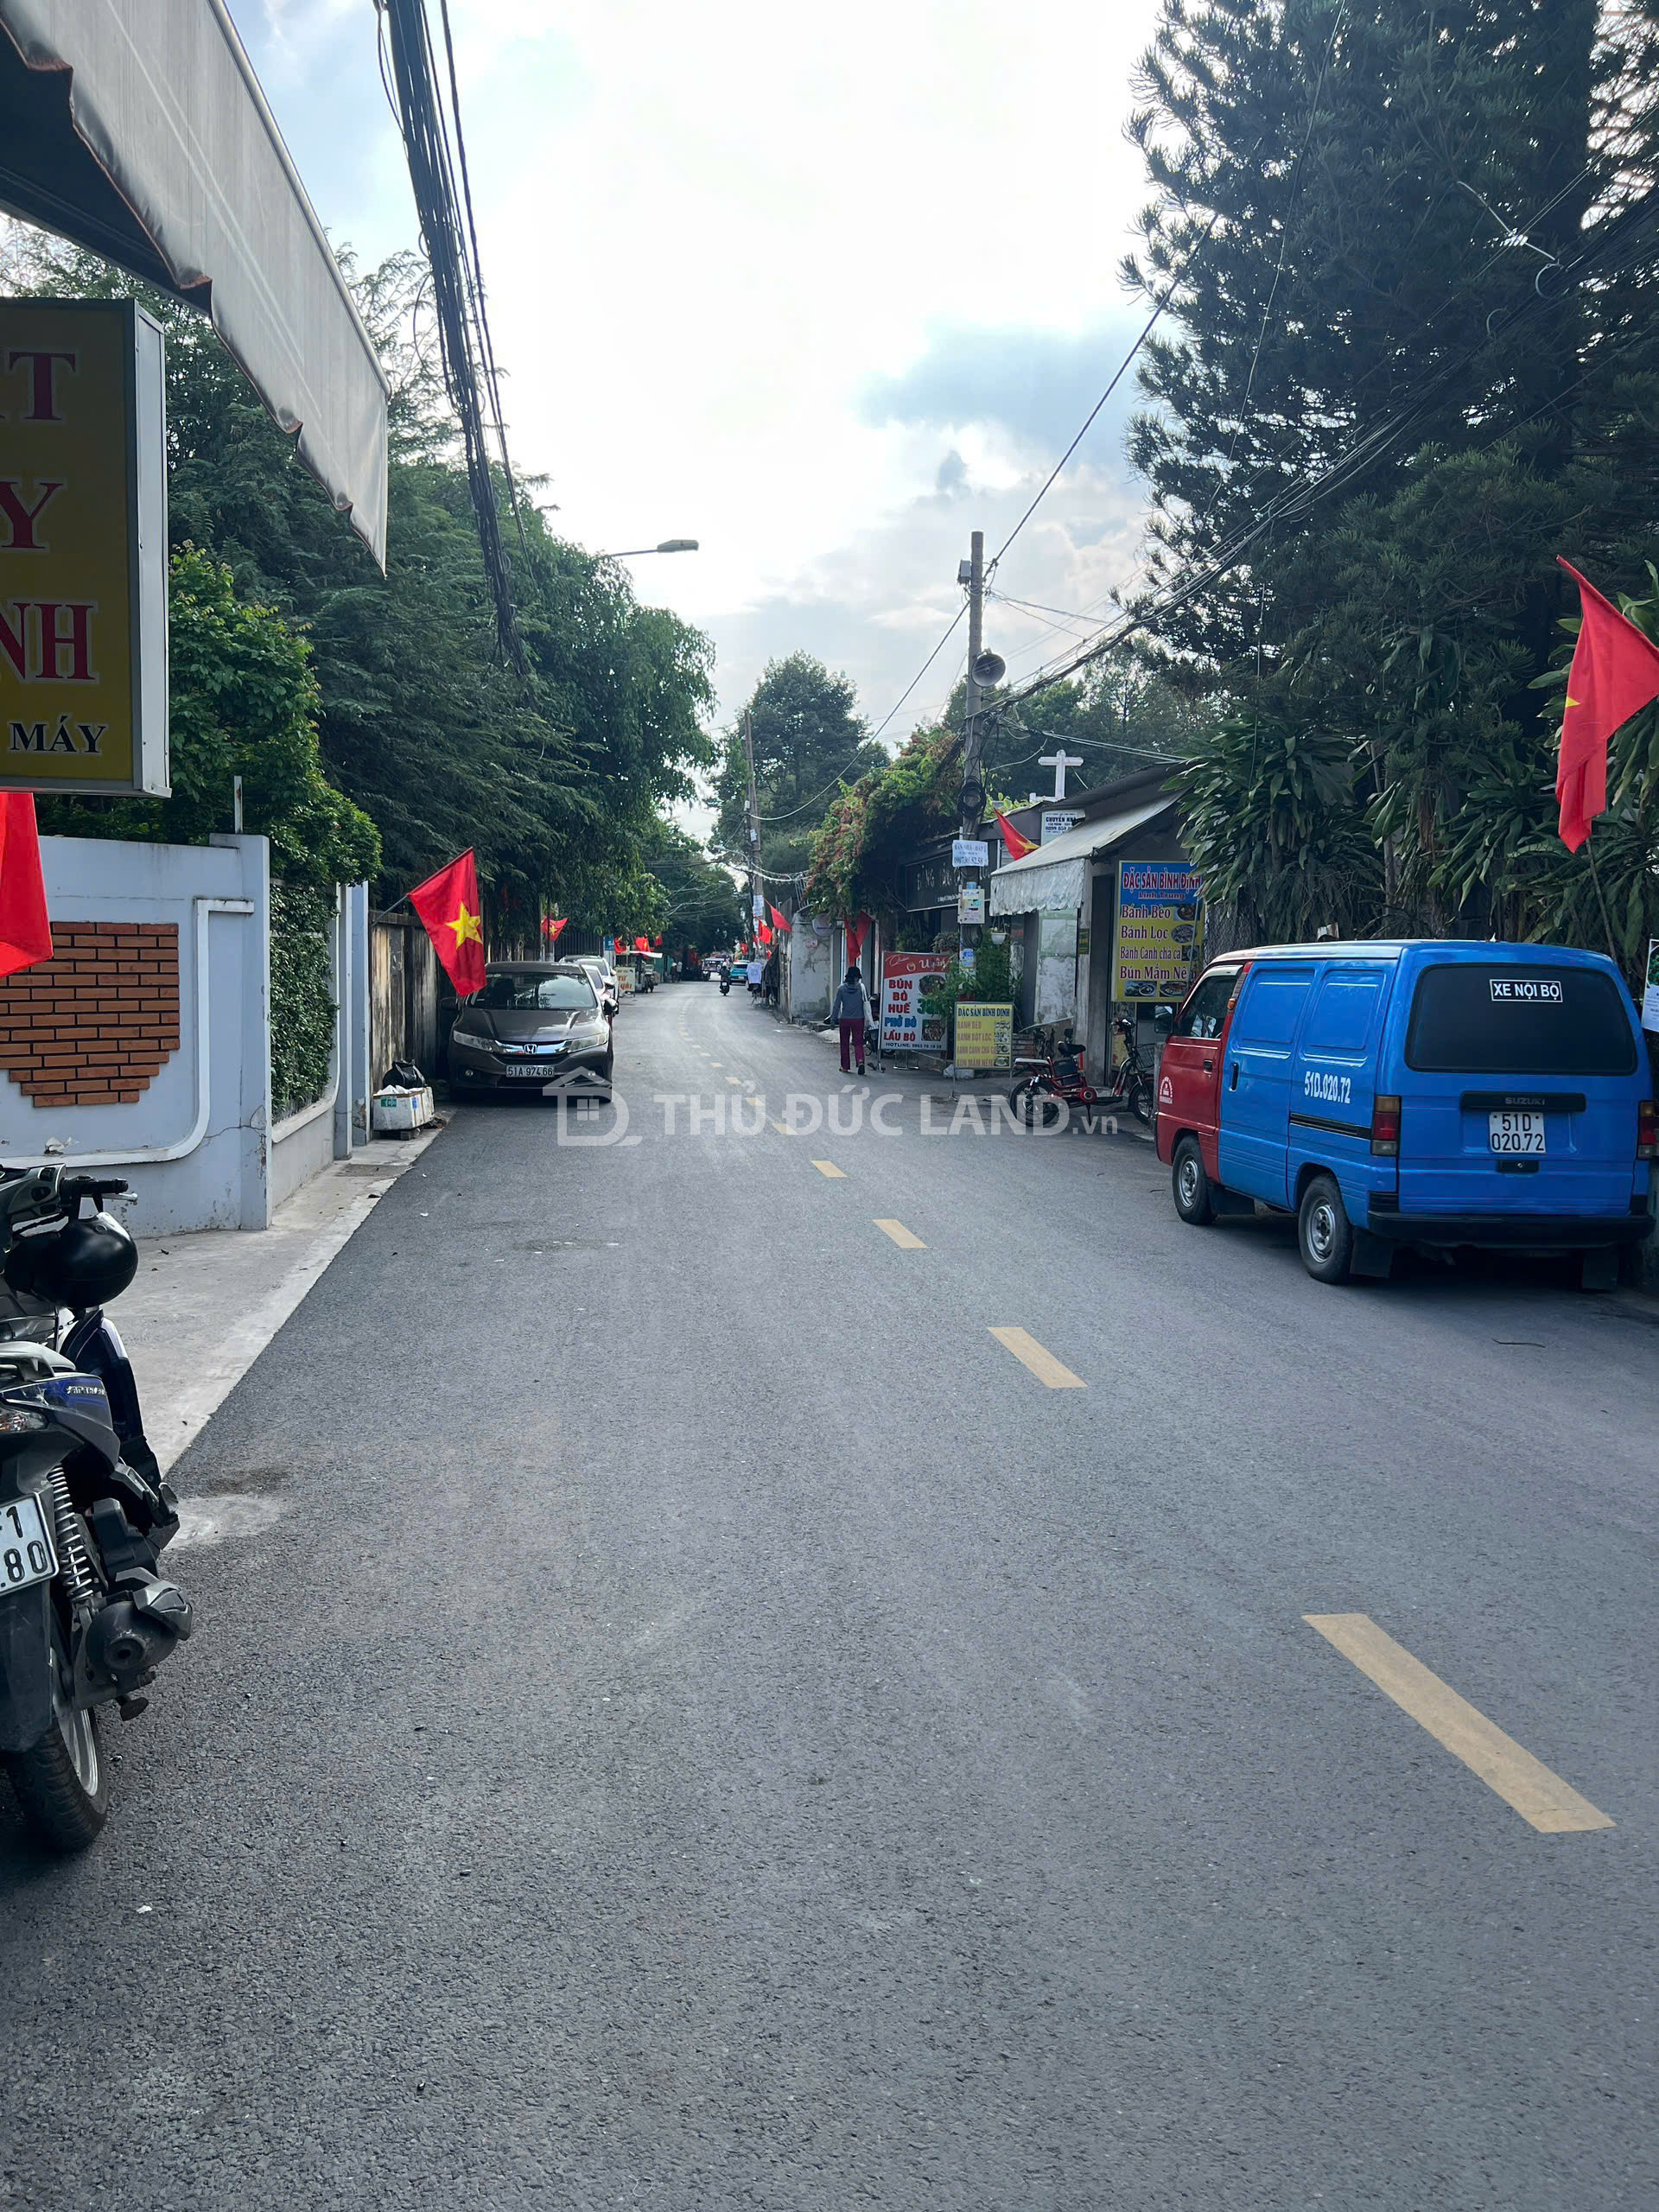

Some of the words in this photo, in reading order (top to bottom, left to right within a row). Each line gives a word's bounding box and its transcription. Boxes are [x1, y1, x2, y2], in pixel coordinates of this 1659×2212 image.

[0, 353, 76, 421] T
[9, 716, 106, 754] MÁY
[1123, 867, 1140, 893] ĐẶC
[1141, 866, 1158, 889] SẢN
[1160, 868, 1179, 889] BÌNH
[1160, 892, 1185, 900] Trung
[1122, 904, 1148, 918] Bánh
[1151, 905, 1171, 918] Bèo
[1121, 924, 1147, 938] Bánh
[1151, 925, 1168, 942] Lọc
[1120, 945, 1139, 959] Bánh
[1141, 946, 1157, 960] Canh
[1120, 965, 1141, 979] Bún
[1144, 963, 1170, 979] Mắm
[893, 990, 908, 1001] BÒ
[1493, 983, 1512, 996] XE
[1514, 982, 1538, 1000] NỘI
[1540, 982, 1560, 1001] BỘ
[888, 1002, 912, 1014] HUẾ
[905, 1015, 917, 1027] BÒ
[903, 1031, 916, 1041] BÒ
[1305, 1071, 1351, 1104] 51D.020.72
[1505, 1096, 1546, 1105] SUZUKI
[1502, 1113, 1531, 1132] 51D
[1491, 1133, 1544, 1151] 020.72
